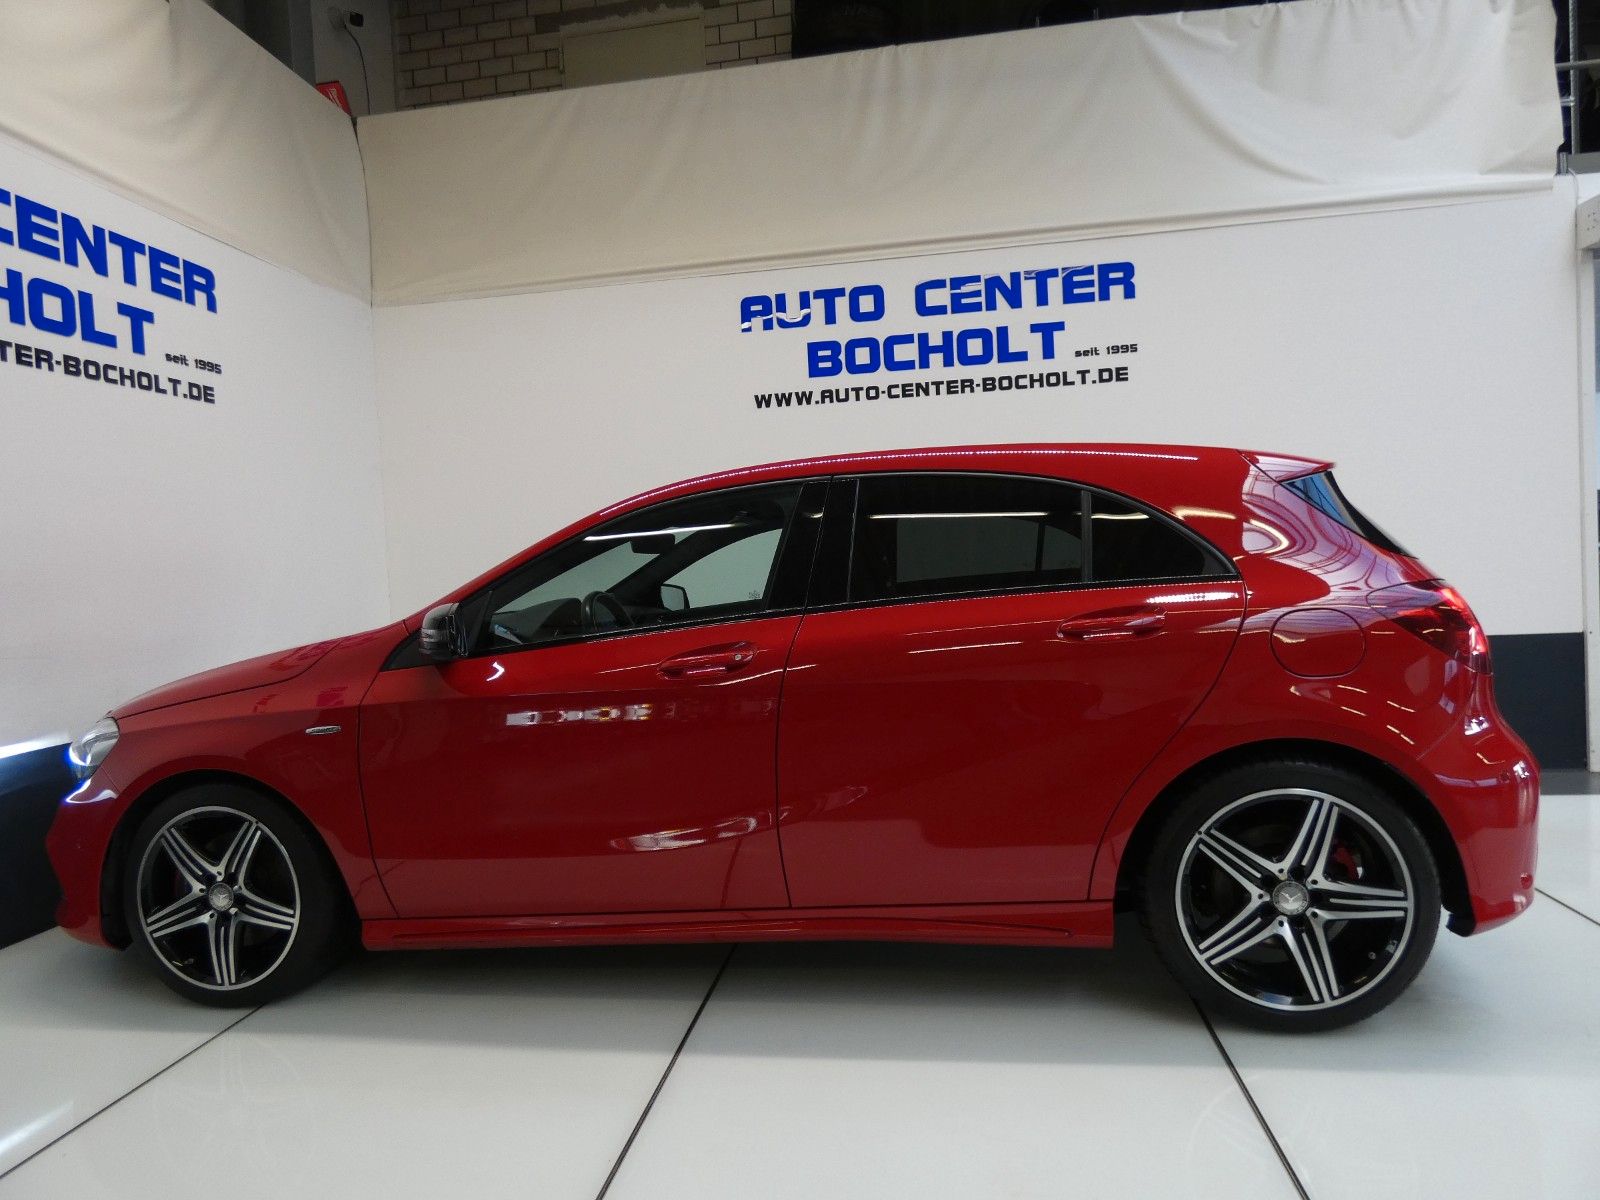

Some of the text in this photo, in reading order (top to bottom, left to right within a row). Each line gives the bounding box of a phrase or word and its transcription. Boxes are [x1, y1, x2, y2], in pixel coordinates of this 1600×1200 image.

[740, 261, 1137, 333] AUTO CENTER
[165, 353, 189, 367] seit
[194, 358, 223, 375] 1995
[806, 320, 1138, 379] BOCHOLT seit 1995
[753, 366, 1129, 409] WWW.AUTO-CENTER-BOCHOLT.DE
